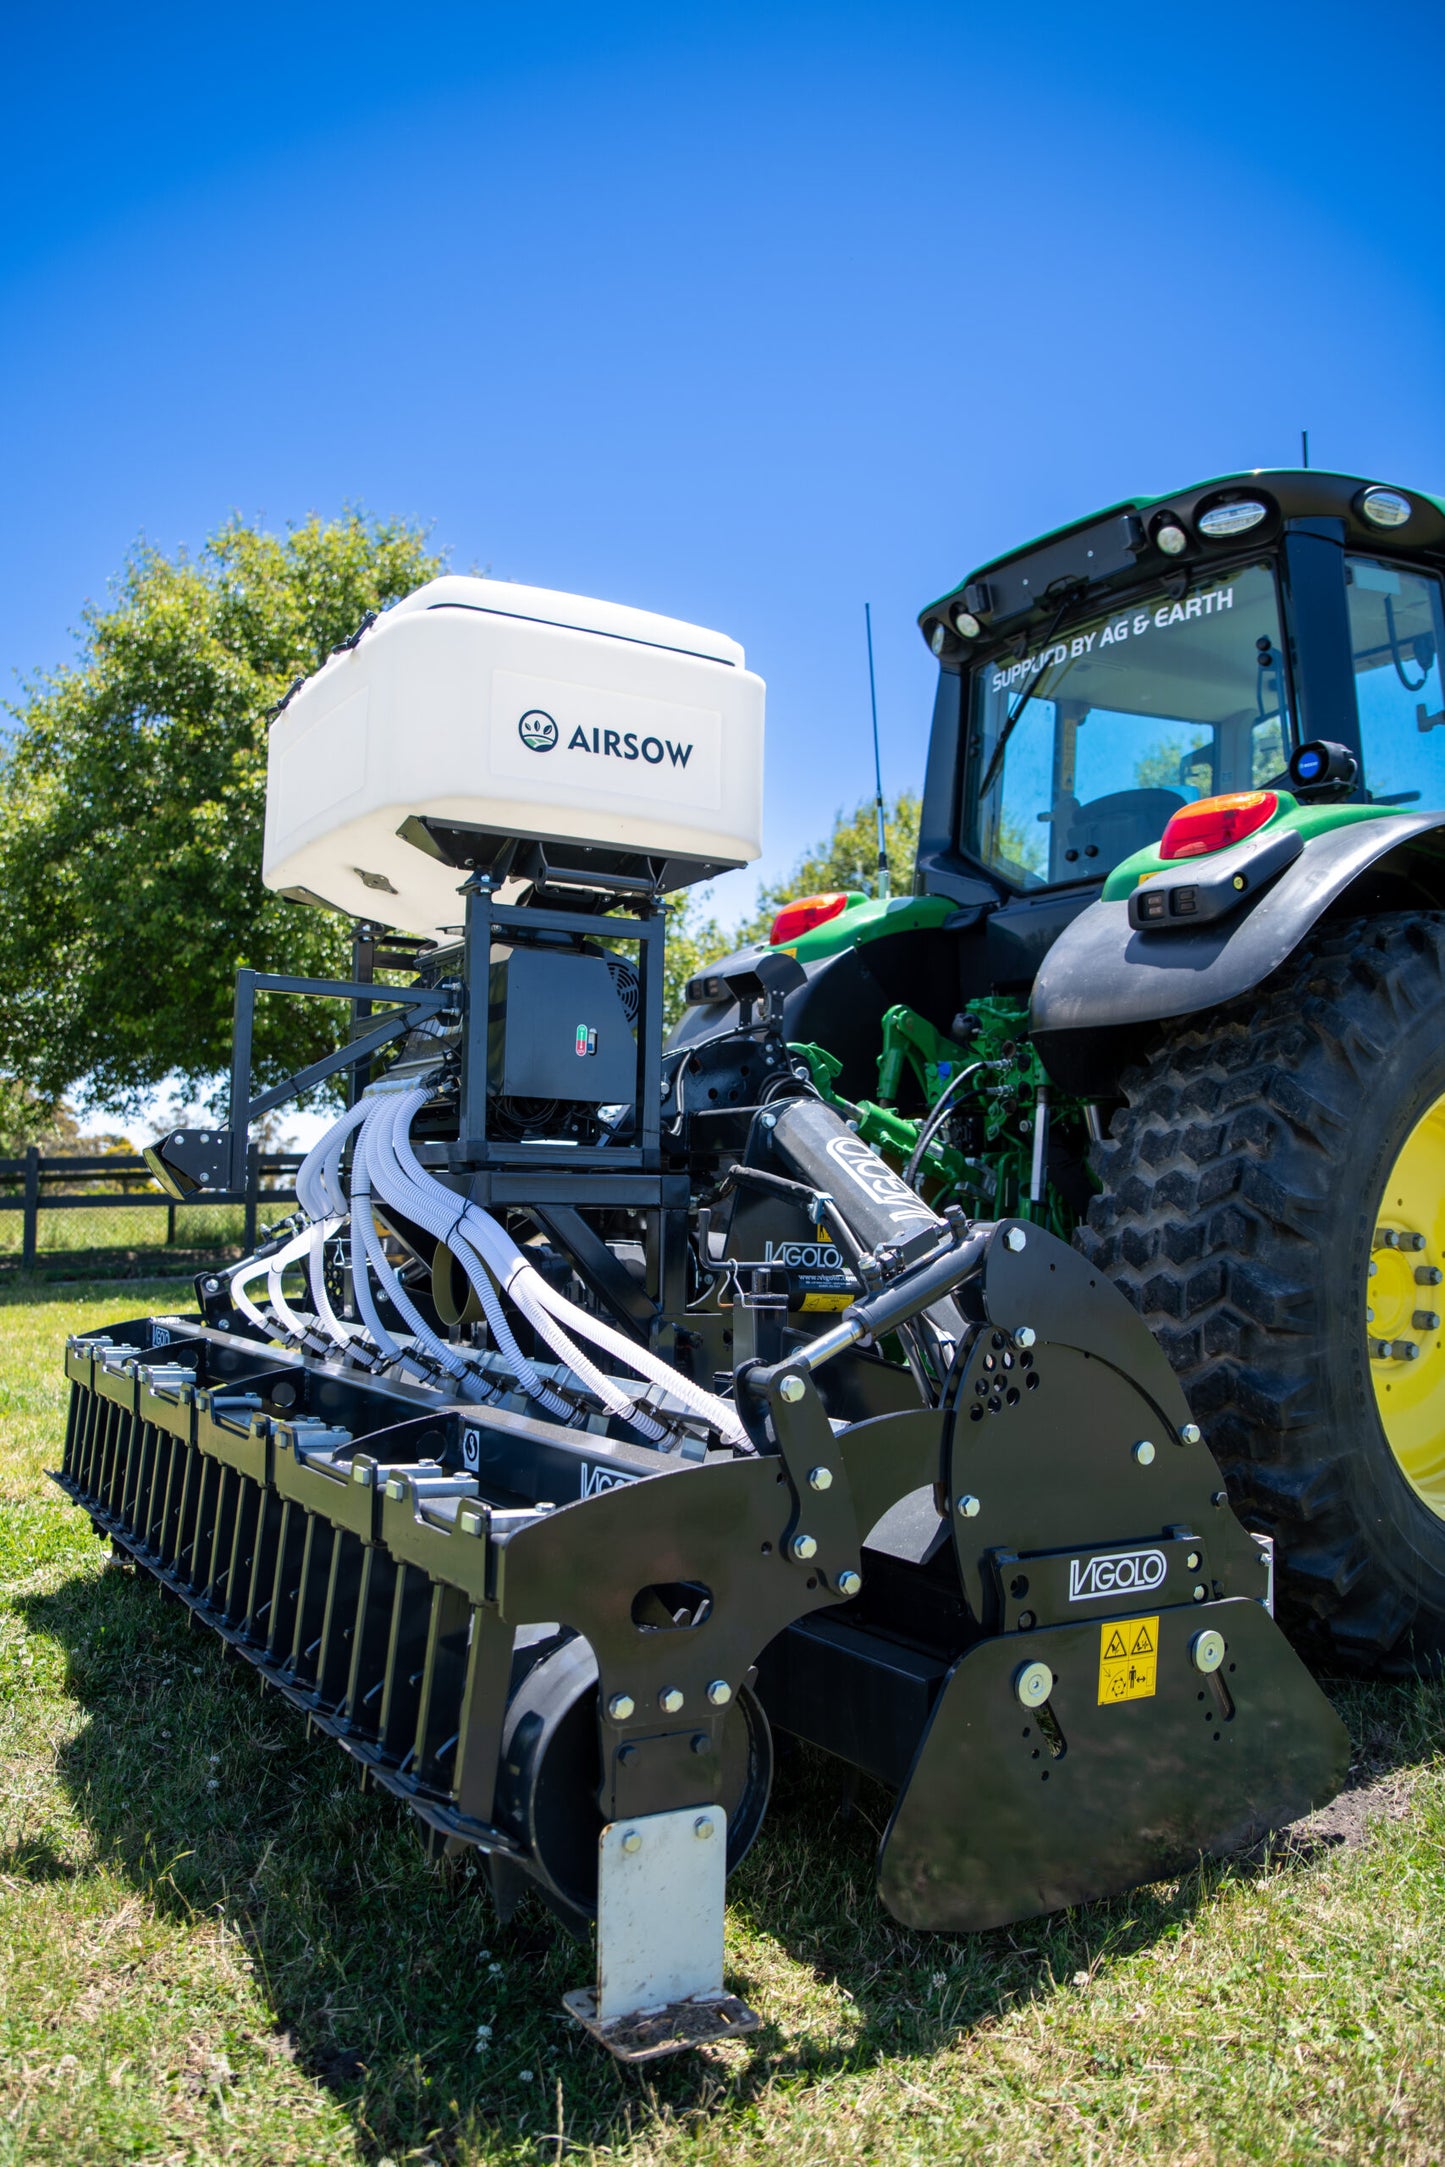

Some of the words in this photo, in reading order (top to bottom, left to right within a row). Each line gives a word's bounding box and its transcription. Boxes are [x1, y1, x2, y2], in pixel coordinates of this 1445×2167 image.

[1071, 631, 1097, 659] BY
[1099, 621, 1129, 648] AG
[1132, 614, 1150, 636] &
[1154, 587, 1234, 628] EARTH
[567, 724, 694, 769] AIRSOW
[765, 1241, 843, 1268] VIGOLO
[1069, 1551, 1166, 1600] VIGOLO
